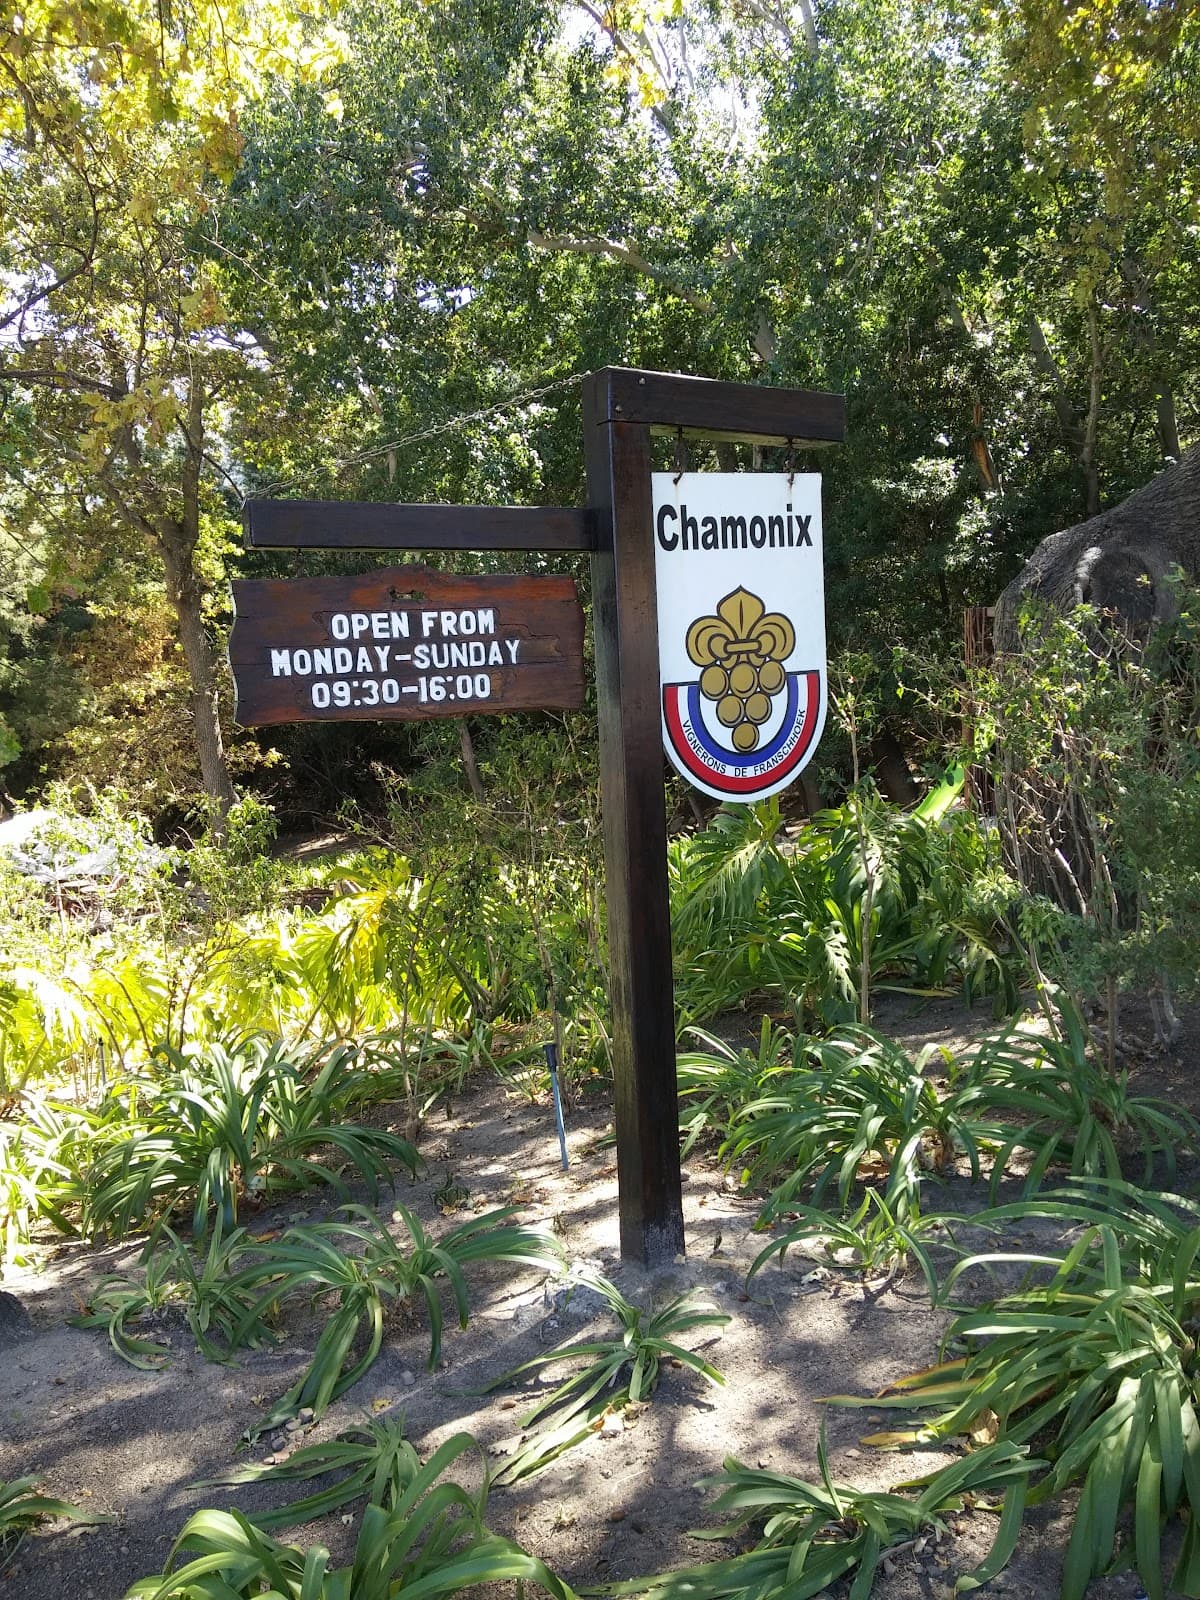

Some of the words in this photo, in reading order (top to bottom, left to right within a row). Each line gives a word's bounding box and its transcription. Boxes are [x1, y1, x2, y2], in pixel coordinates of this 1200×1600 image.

[657, 503, 813, 551] Chamonix
[331, 611, 410, 640] OPEN
[421, 608, 495, 637] FROM
[682, 719, 727, 774] VIGNERONS
[734, 767, 748, 777] DE
[754, 709, 806, 776] FRANSCHHOEK
